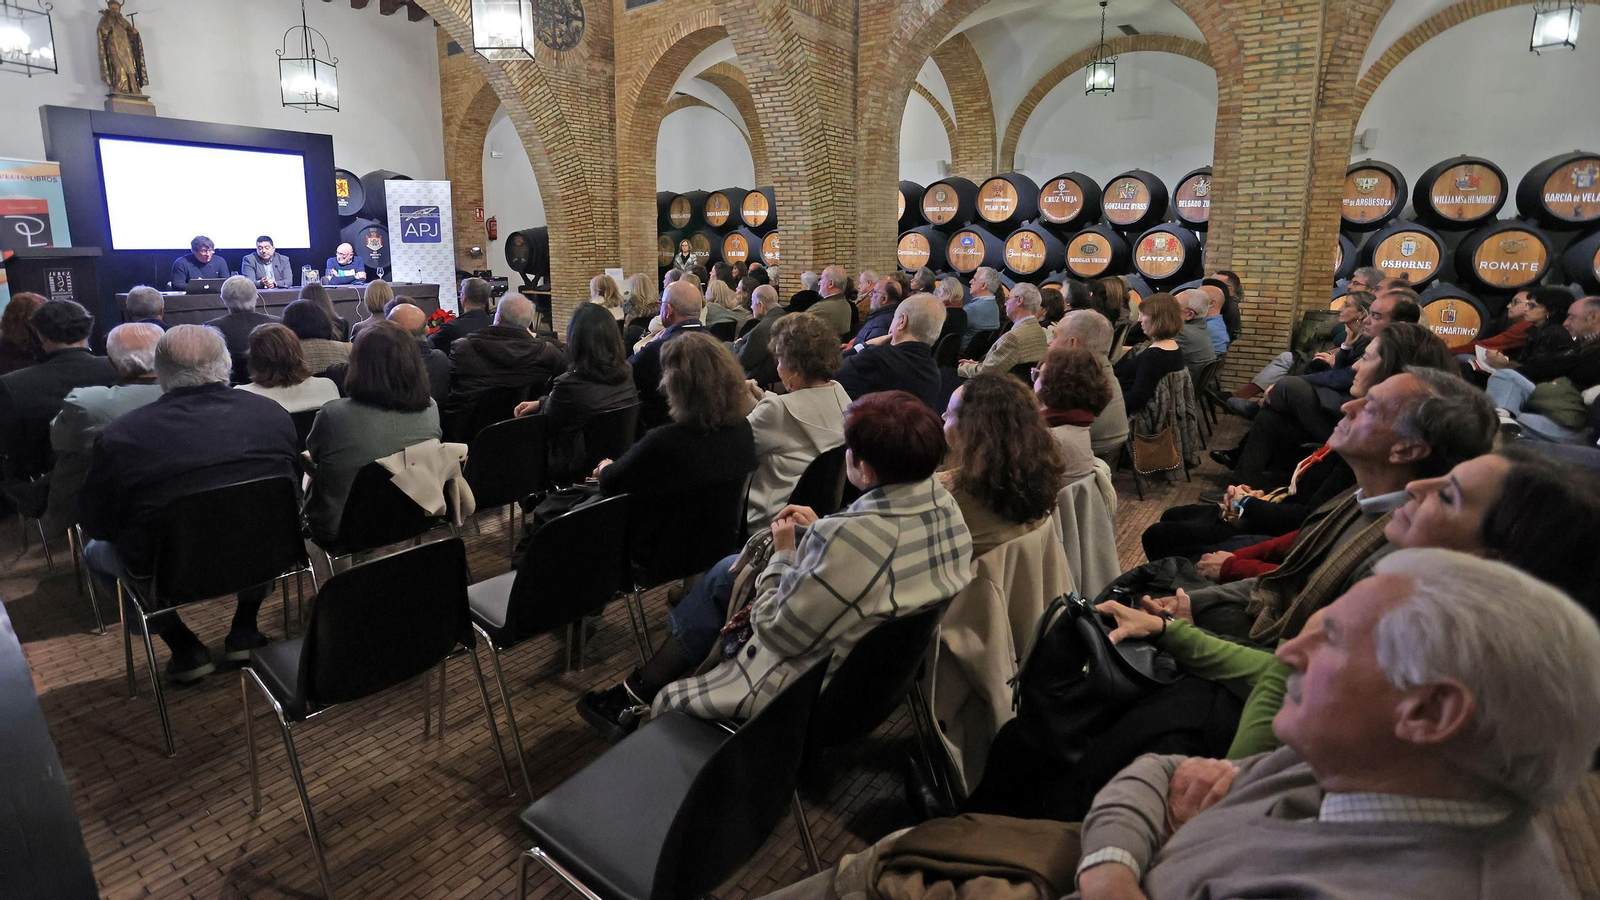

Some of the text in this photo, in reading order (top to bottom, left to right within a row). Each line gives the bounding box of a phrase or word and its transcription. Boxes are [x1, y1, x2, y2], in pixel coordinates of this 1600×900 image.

[30, 175, 58, 183] LIBROS
[1061, 195, 1077, 204] VIEJA
[1355, 197, 1385, 207] ARGÜESO
[1434, 195, 1464, 204] WILLIAMS
[1467, 195, 1497, 204] HUMBERT
[1544, 193, 1572, 203] GARCIA
[1104, 202, 1147, 210] GONZALEZ BYASS
[1178, 200, 1202, 208] DELGADO
[404, 222, 439, 238] APJ
[1381, 260, 1432, 270] OSBORNE
[1479, 261, 1540, 272] ROMATE
[1434, 325, 1468, 335] PEMARTIN
